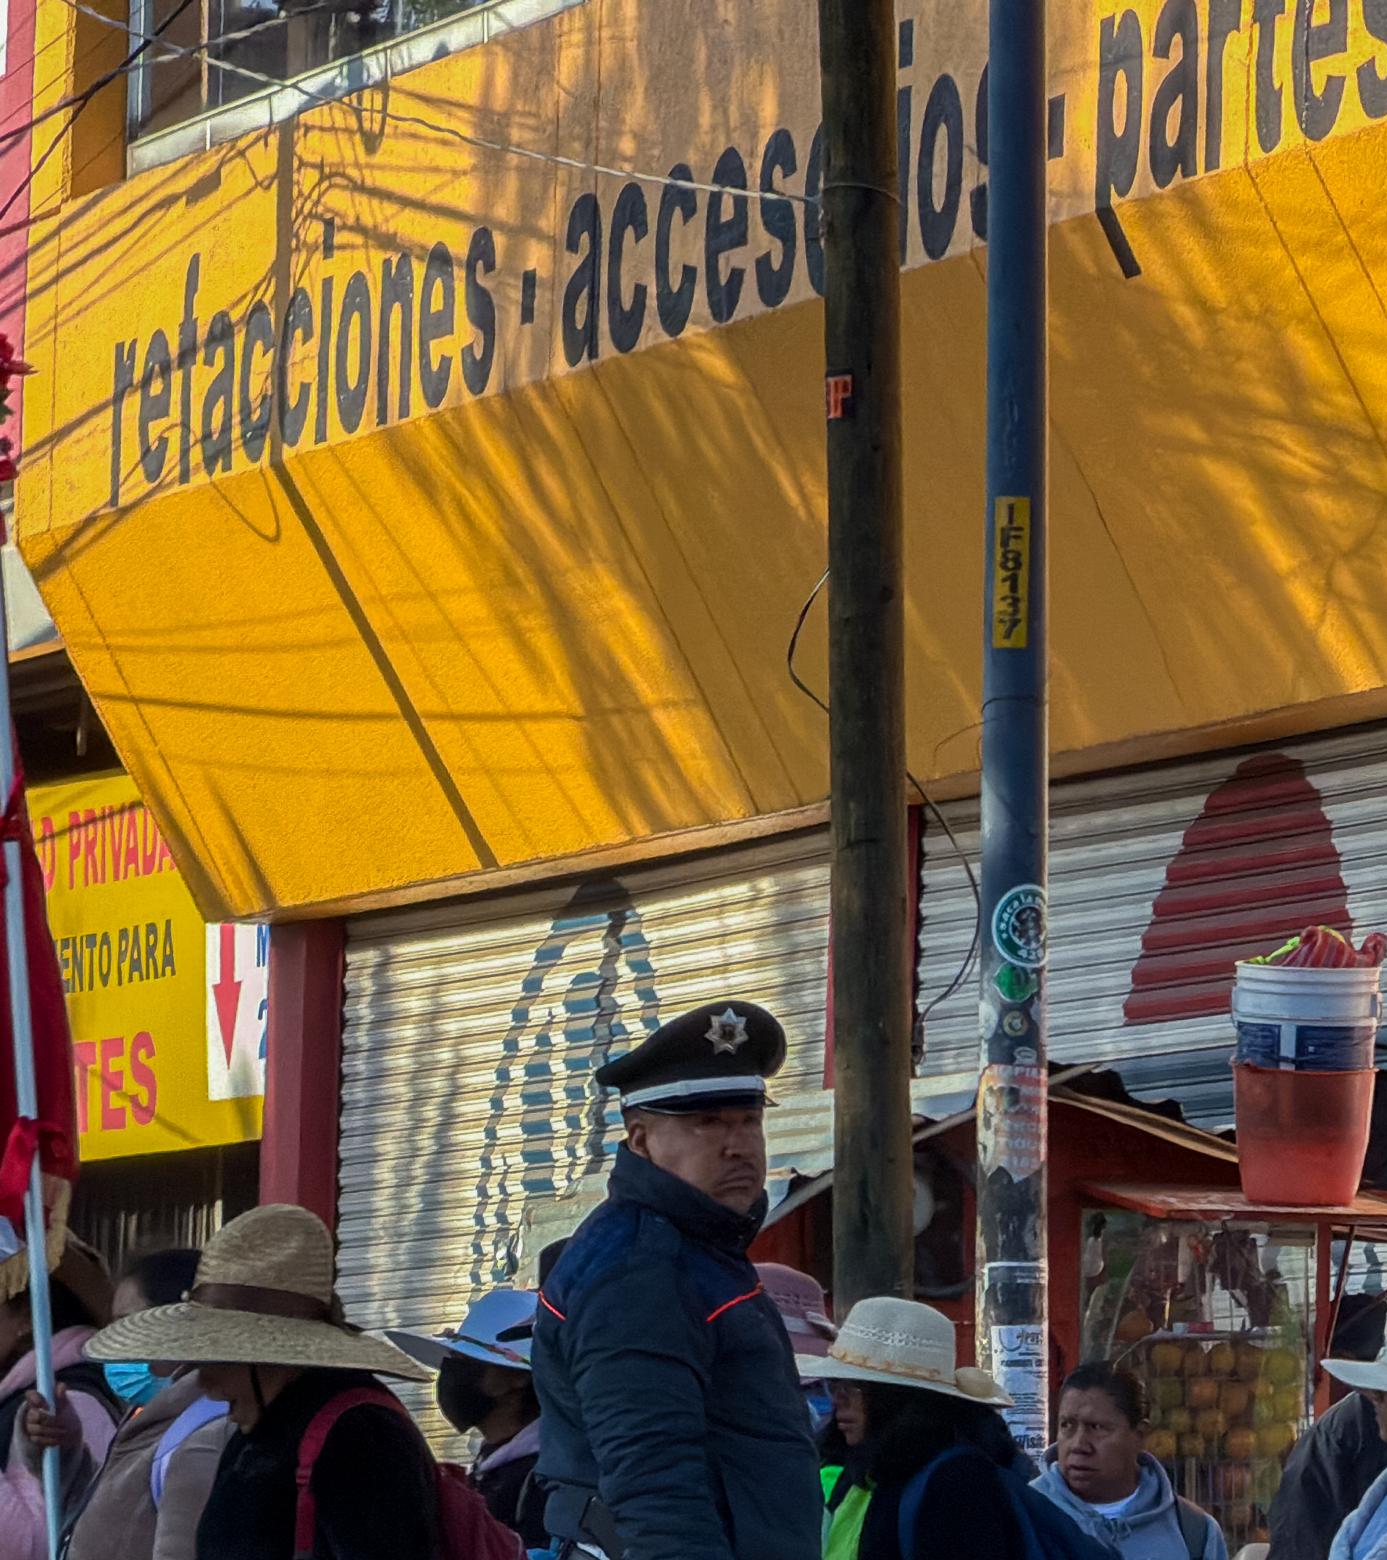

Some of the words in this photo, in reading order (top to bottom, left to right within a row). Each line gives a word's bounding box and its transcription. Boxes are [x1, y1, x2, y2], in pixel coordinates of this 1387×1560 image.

[110, 220, 496, 507] refacciones
[562, 19, 990, 367] accesio
[58, 932, 112, 993] ENTO
[118, 919, 176, 986] PARA
[73, 1031, 158, 1132] TES
